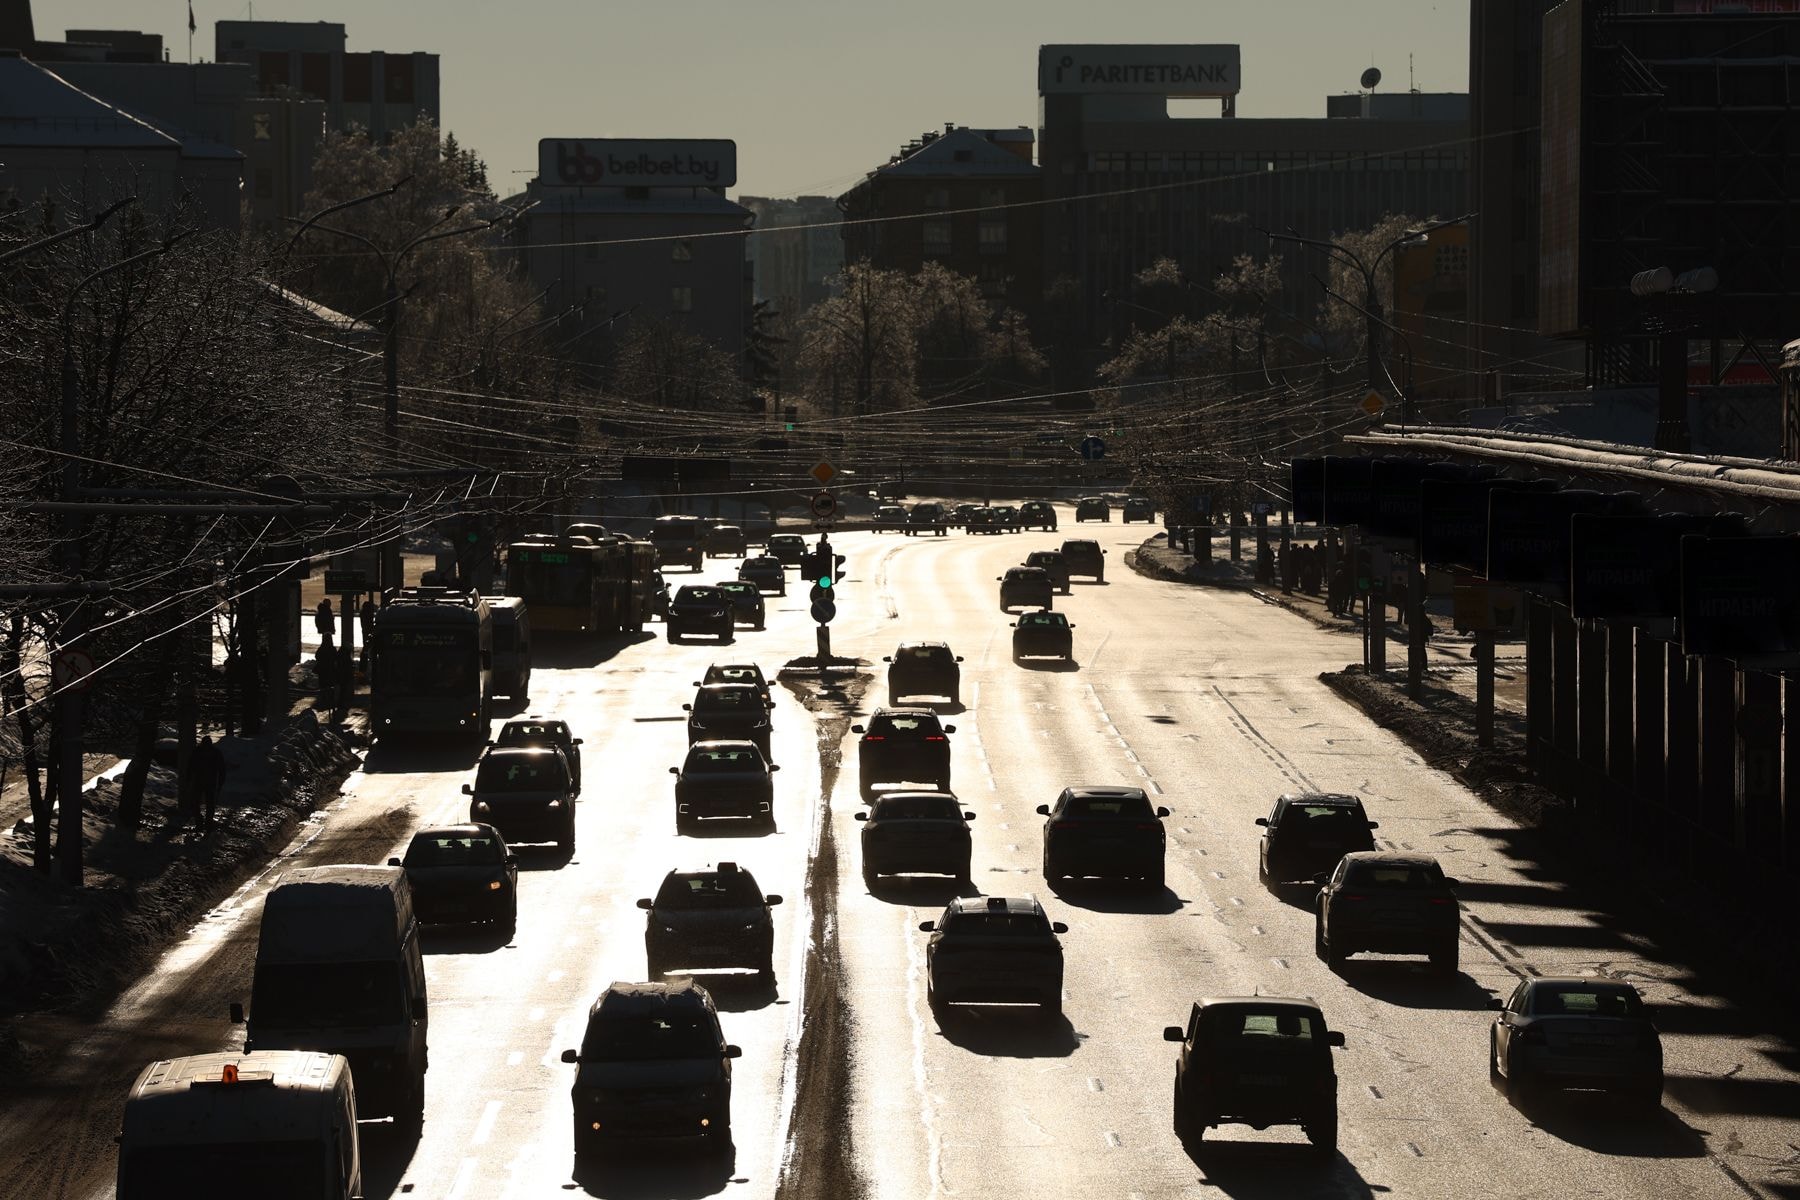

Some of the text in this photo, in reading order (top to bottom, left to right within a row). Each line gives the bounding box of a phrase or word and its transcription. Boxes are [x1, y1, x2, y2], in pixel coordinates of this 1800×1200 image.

[1080, 64, 1228, 83] PARITETBANK
[608, 154, 719, 181] belbet.by
[1698, 597, 1777, 617] ИГРАЕМ?
